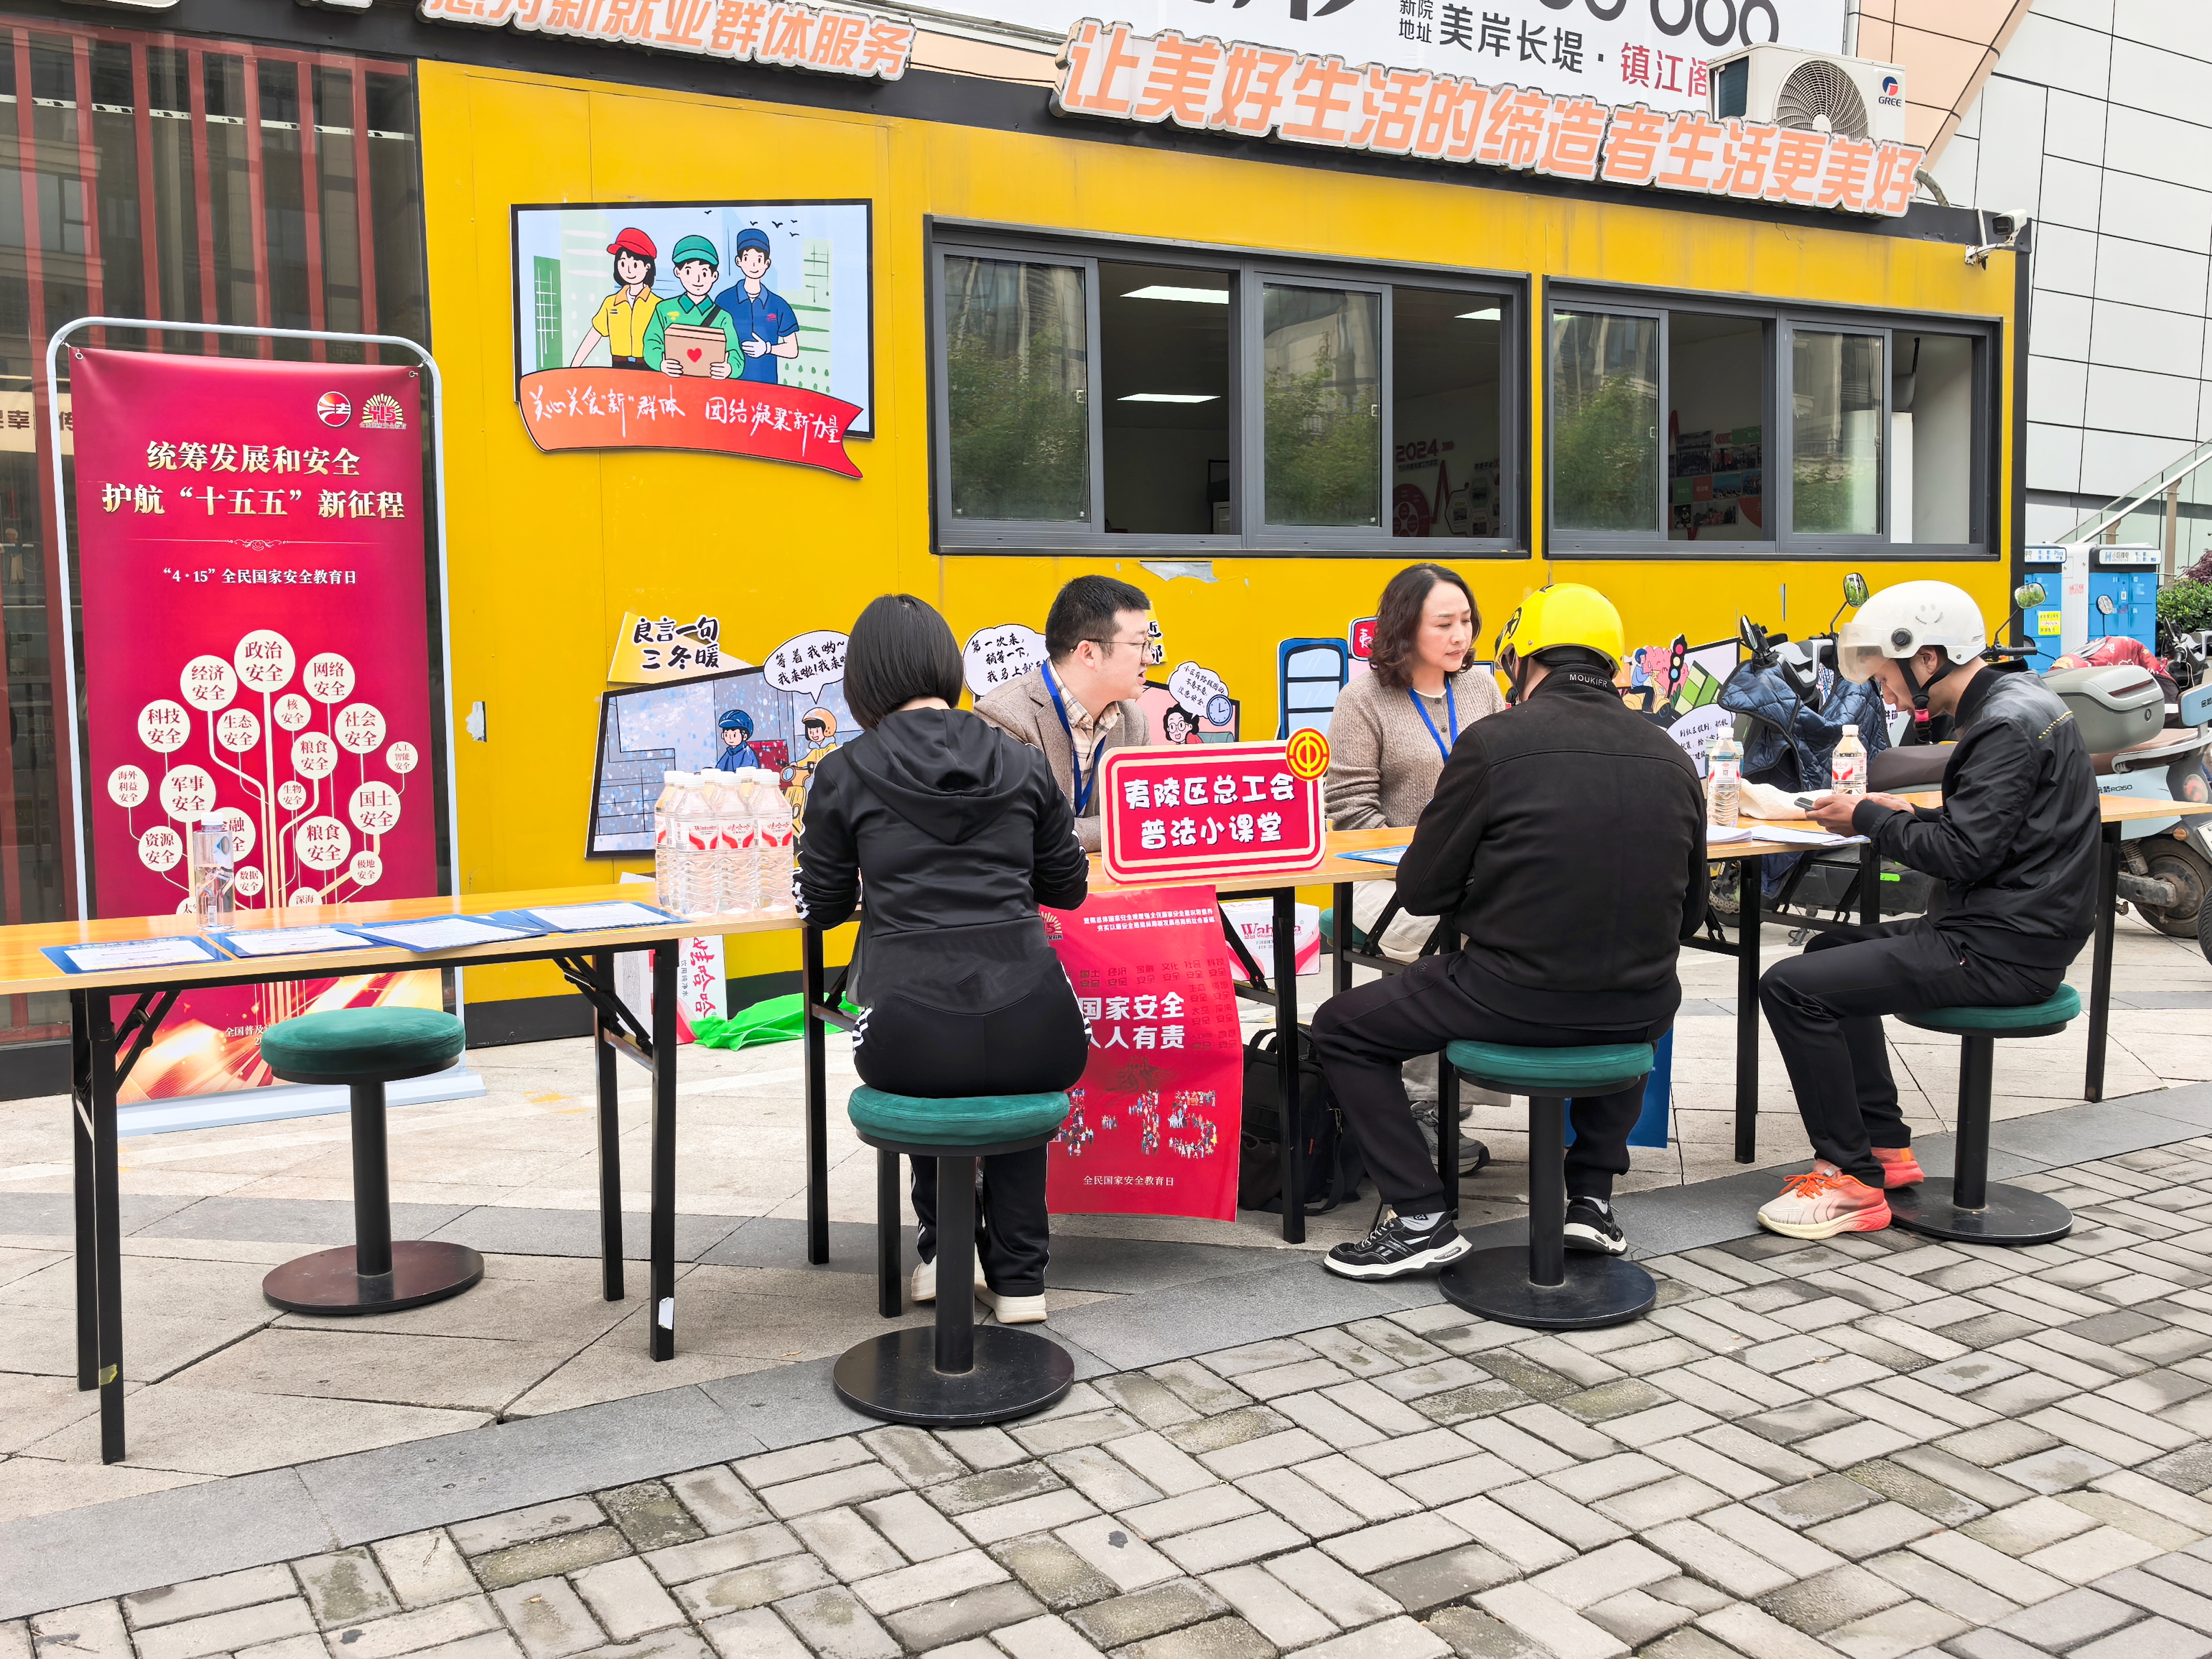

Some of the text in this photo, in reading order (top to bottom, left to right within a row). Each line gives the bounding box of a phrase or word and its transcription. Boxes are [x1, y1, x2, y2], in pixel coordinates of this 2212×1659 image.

[1400, 0, 1433, 21] 新院
[431, 0, 913, 74] 新就业群体服务
[1399, 19, 1432, 44] 地址
[1878, 96, 1901, 107] GREE
[1065, 24, 1925, 213] 让美好生活的缔造者生活更美好
[146, 440, 360, 476] 统筹发展和安全
[1395, 439, 1438, 463] 2024
[102, 483, 165, 515] 护航
[318, 489, 405, 520] 新征程
[221, 568, 358, 585] 全民国家安全教育日
[633, 617, 719, 644] 良言一句
[245, 641, 282, 659] 政治
[641, 644, 720, 671] 三冬暖
[191, 665, 224, 682] 经济
[246, 665, 284, 682] 安全
[314, 662, 345, 678] 网络
[192, 685, 225, 702] 安全
[314, 681, 345, 697] 安全
[287, 699, 298, 711] 核
[147, 707, 181, 726] 科技
[224, 714, 252, 730] 生态
[281, 711, 305, 725] 安全
[345, 711, 376, 727] 社会
[148, 727, 181, 745] 安全
[224, 731, 253, 746] 安全
[345, 731, 377, 747] 安全
[300, 740, 328, 754] 粮食
[301, 757, 328, 772] 安全
[395, 762, 410, 771] 安全
[118, 770, 137, 780] 海外
[171, 775, 204, 792] 军事
[119, 782, 138, 792] 利益
[283, 784, 301, 794] 生物
[1124, 773, 1295, 811] 夷陵区总工会
[119, 793, 138, 802] 安全
[172, 795, 205, 812] 安全
[284, 795, 302, 805] 安全
[360, 790, 393, 807] 国土
[360, 811, 393, 828] 安全
[306, 824, 340, 841] 粮食
[1141, 812, 1282, 849] 普法小课堂
[146, 832, 174, 848] 资源
[146, 849, 174, 865] 安全
[307, 844, 341, 862] 安全
[358, 859, 375, 869] 极地
[240, 870, 259, 880] 数据
[358, 870, 375, 880] 安全
[240, 882, 259, 892] 安全
[1240, 923, 1301, 939] Waha
[680, 960, 689, 997] 饮用纯净水
[690, 936, 716, 1018] 娃哈哈
[1078, 992, 1184, 1020] 国家安全
[1083, 1176, 1174, 1186] 全民国家安全教育日
